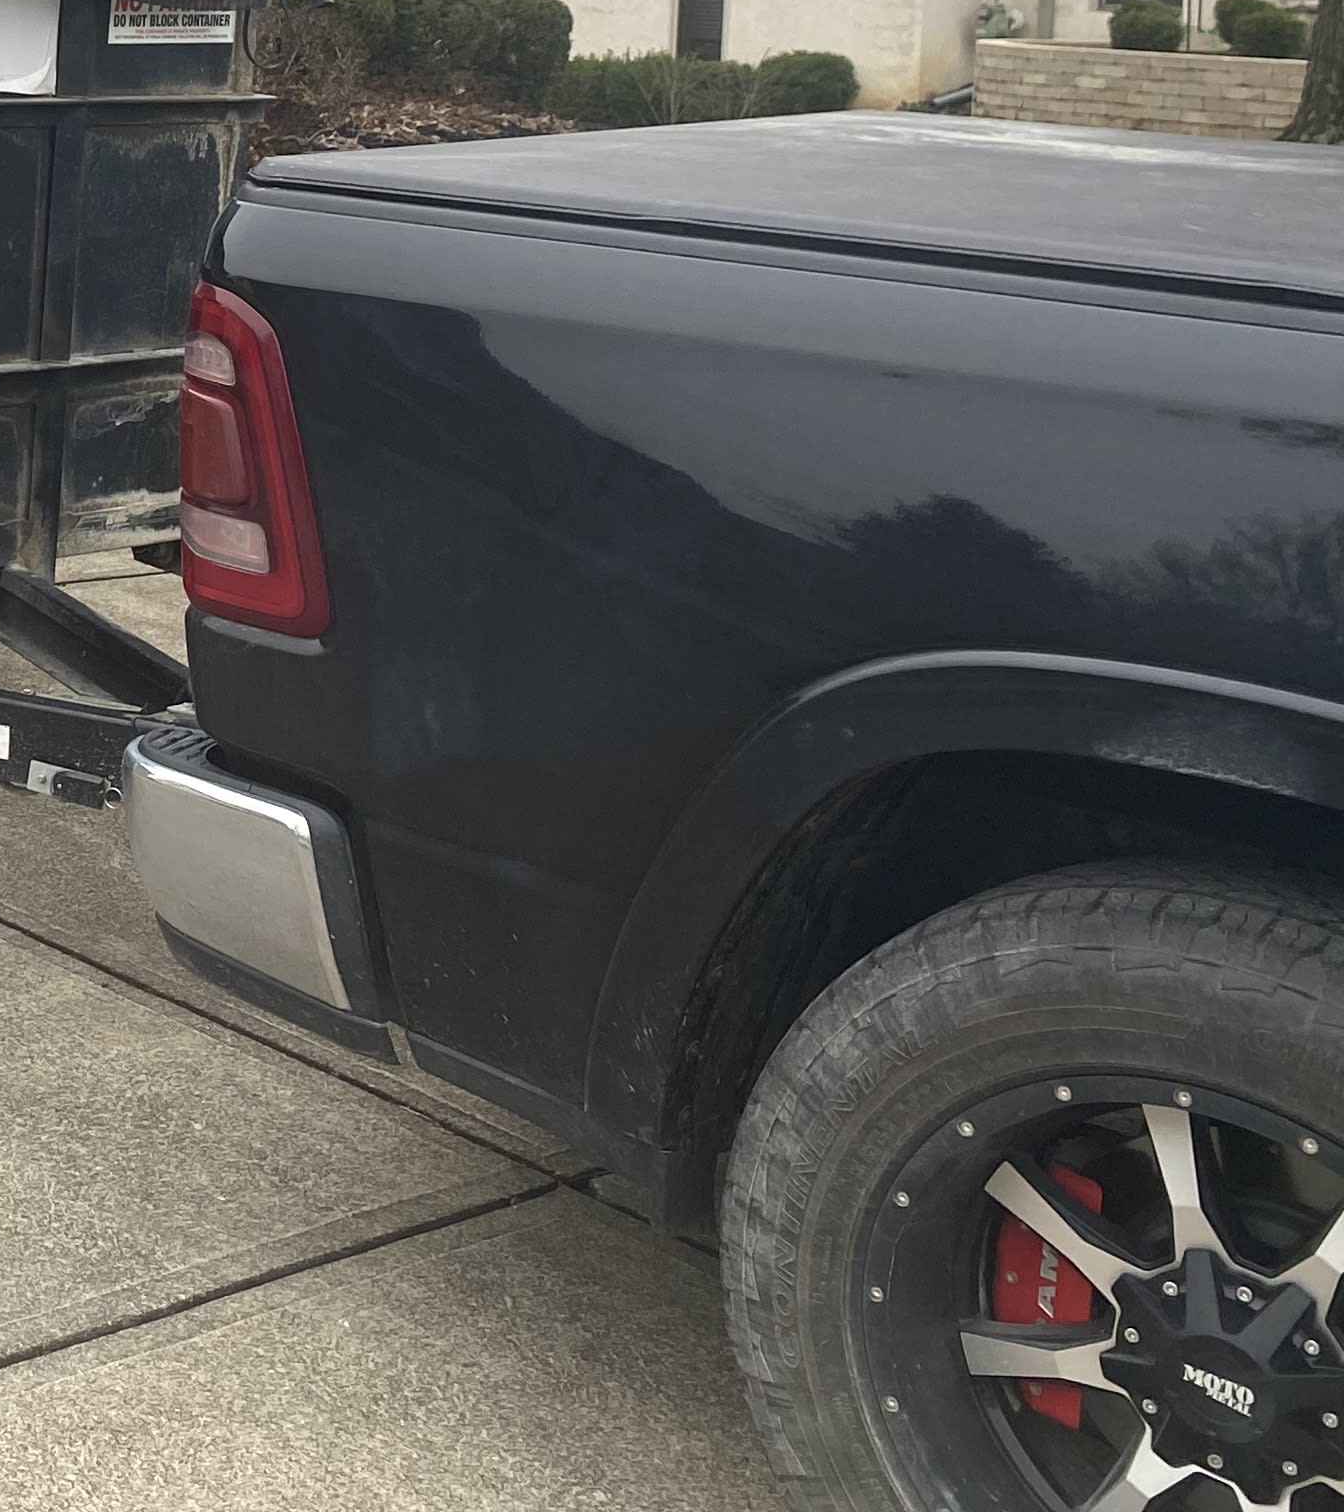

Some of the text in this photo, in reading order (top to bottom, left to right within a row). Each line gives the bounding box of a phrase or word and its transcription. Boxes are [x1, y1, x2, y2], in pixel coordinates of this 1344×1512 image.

[113, 14, 231, 27] DO NOT BLOCK CONTAINER
[772, 1028, 940, 1369] CONTINENTAL
[1183, 1363, 1255, 1405] MOTO
[1205, 1388, 1252, 1417] METAL
